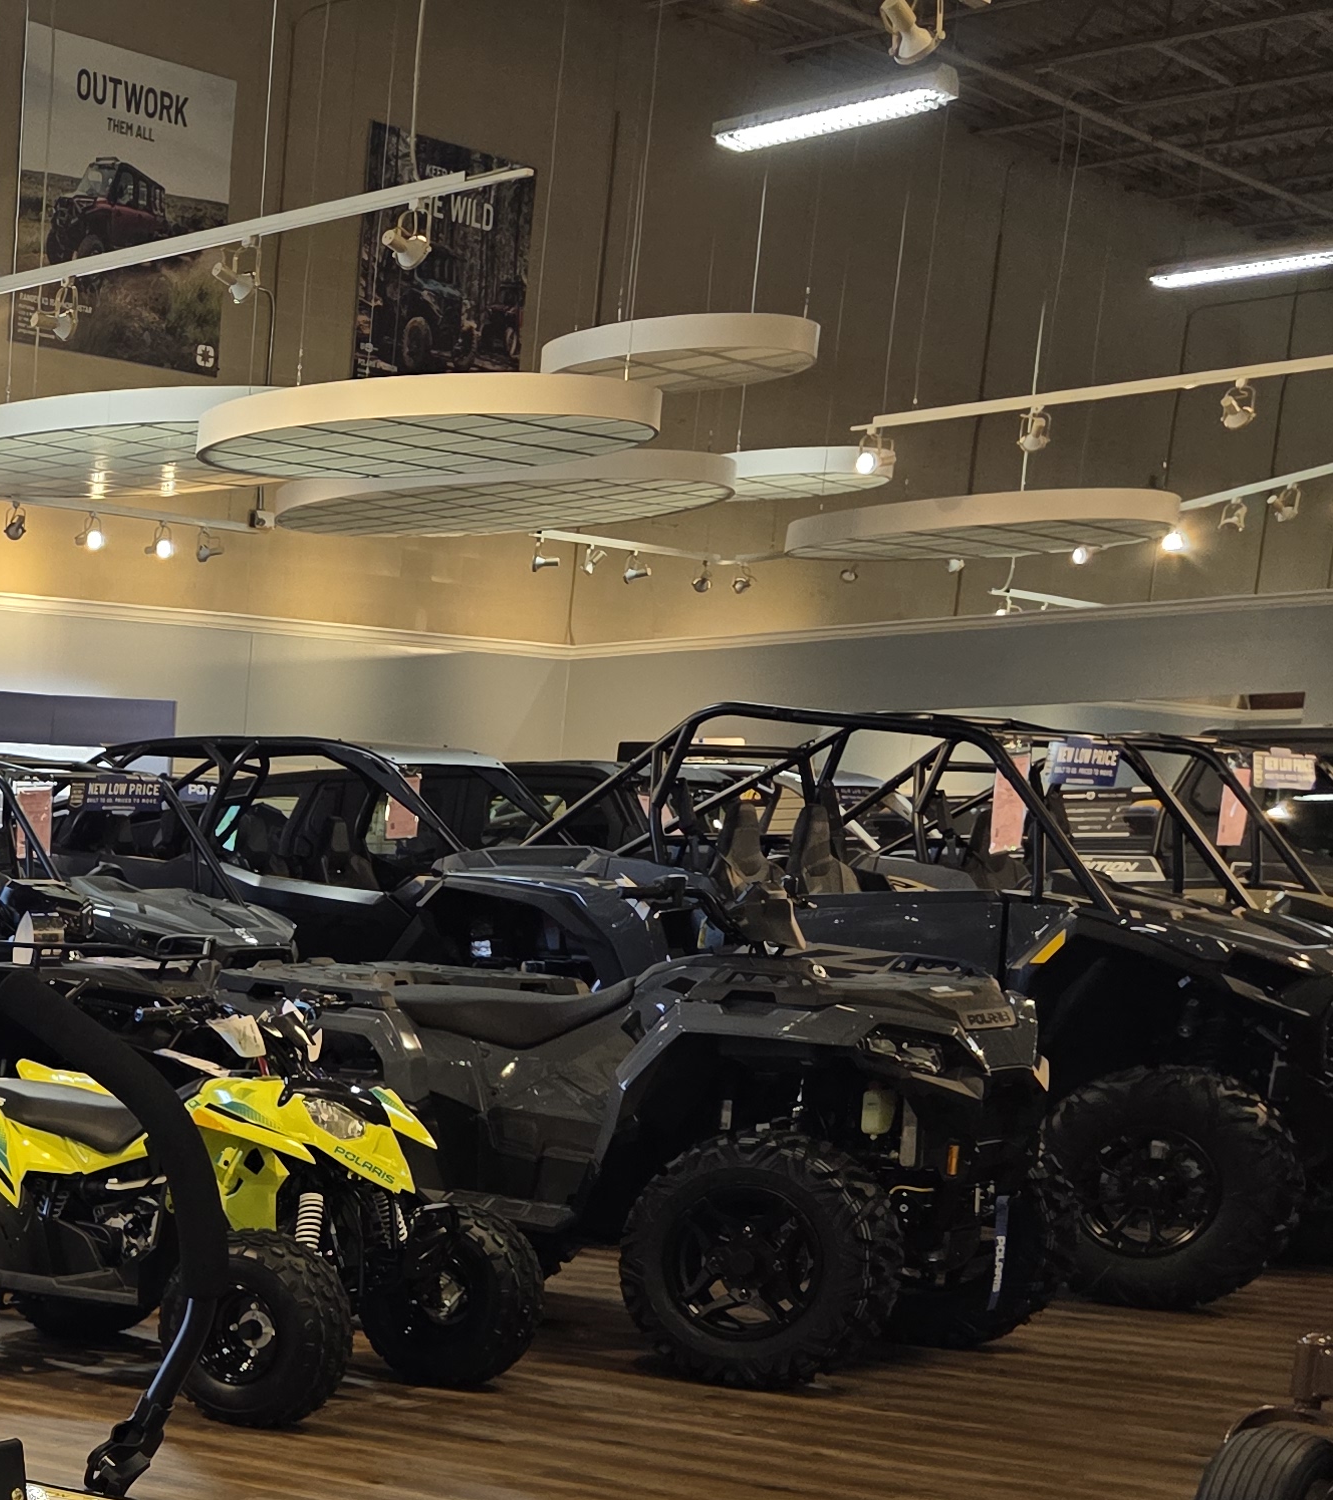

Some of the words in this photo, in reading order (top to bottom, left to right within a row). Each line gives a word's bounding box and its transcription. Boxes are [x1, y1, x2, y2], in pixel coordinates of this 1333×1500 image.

[76, 68, 189, 128] OUTWORK
[107, 117, 133, 137] THEM
[135, 124, 155, 142] ALL
[451, 194, 494, 231] WILD
[1074, 747, 1092, 764] LOW
[1091, 749, 1119, 766] PRICE
[88, 782, 107, 795] NEW
[108, 783, 128, 796] LOW
[128, 783, 161, 796] PRICE
[1083, 860, 1140, 872] ITION
[334, 1146, 395, 1184] POLARIS
[992, 1235, 1006, 1292] POLARIS
